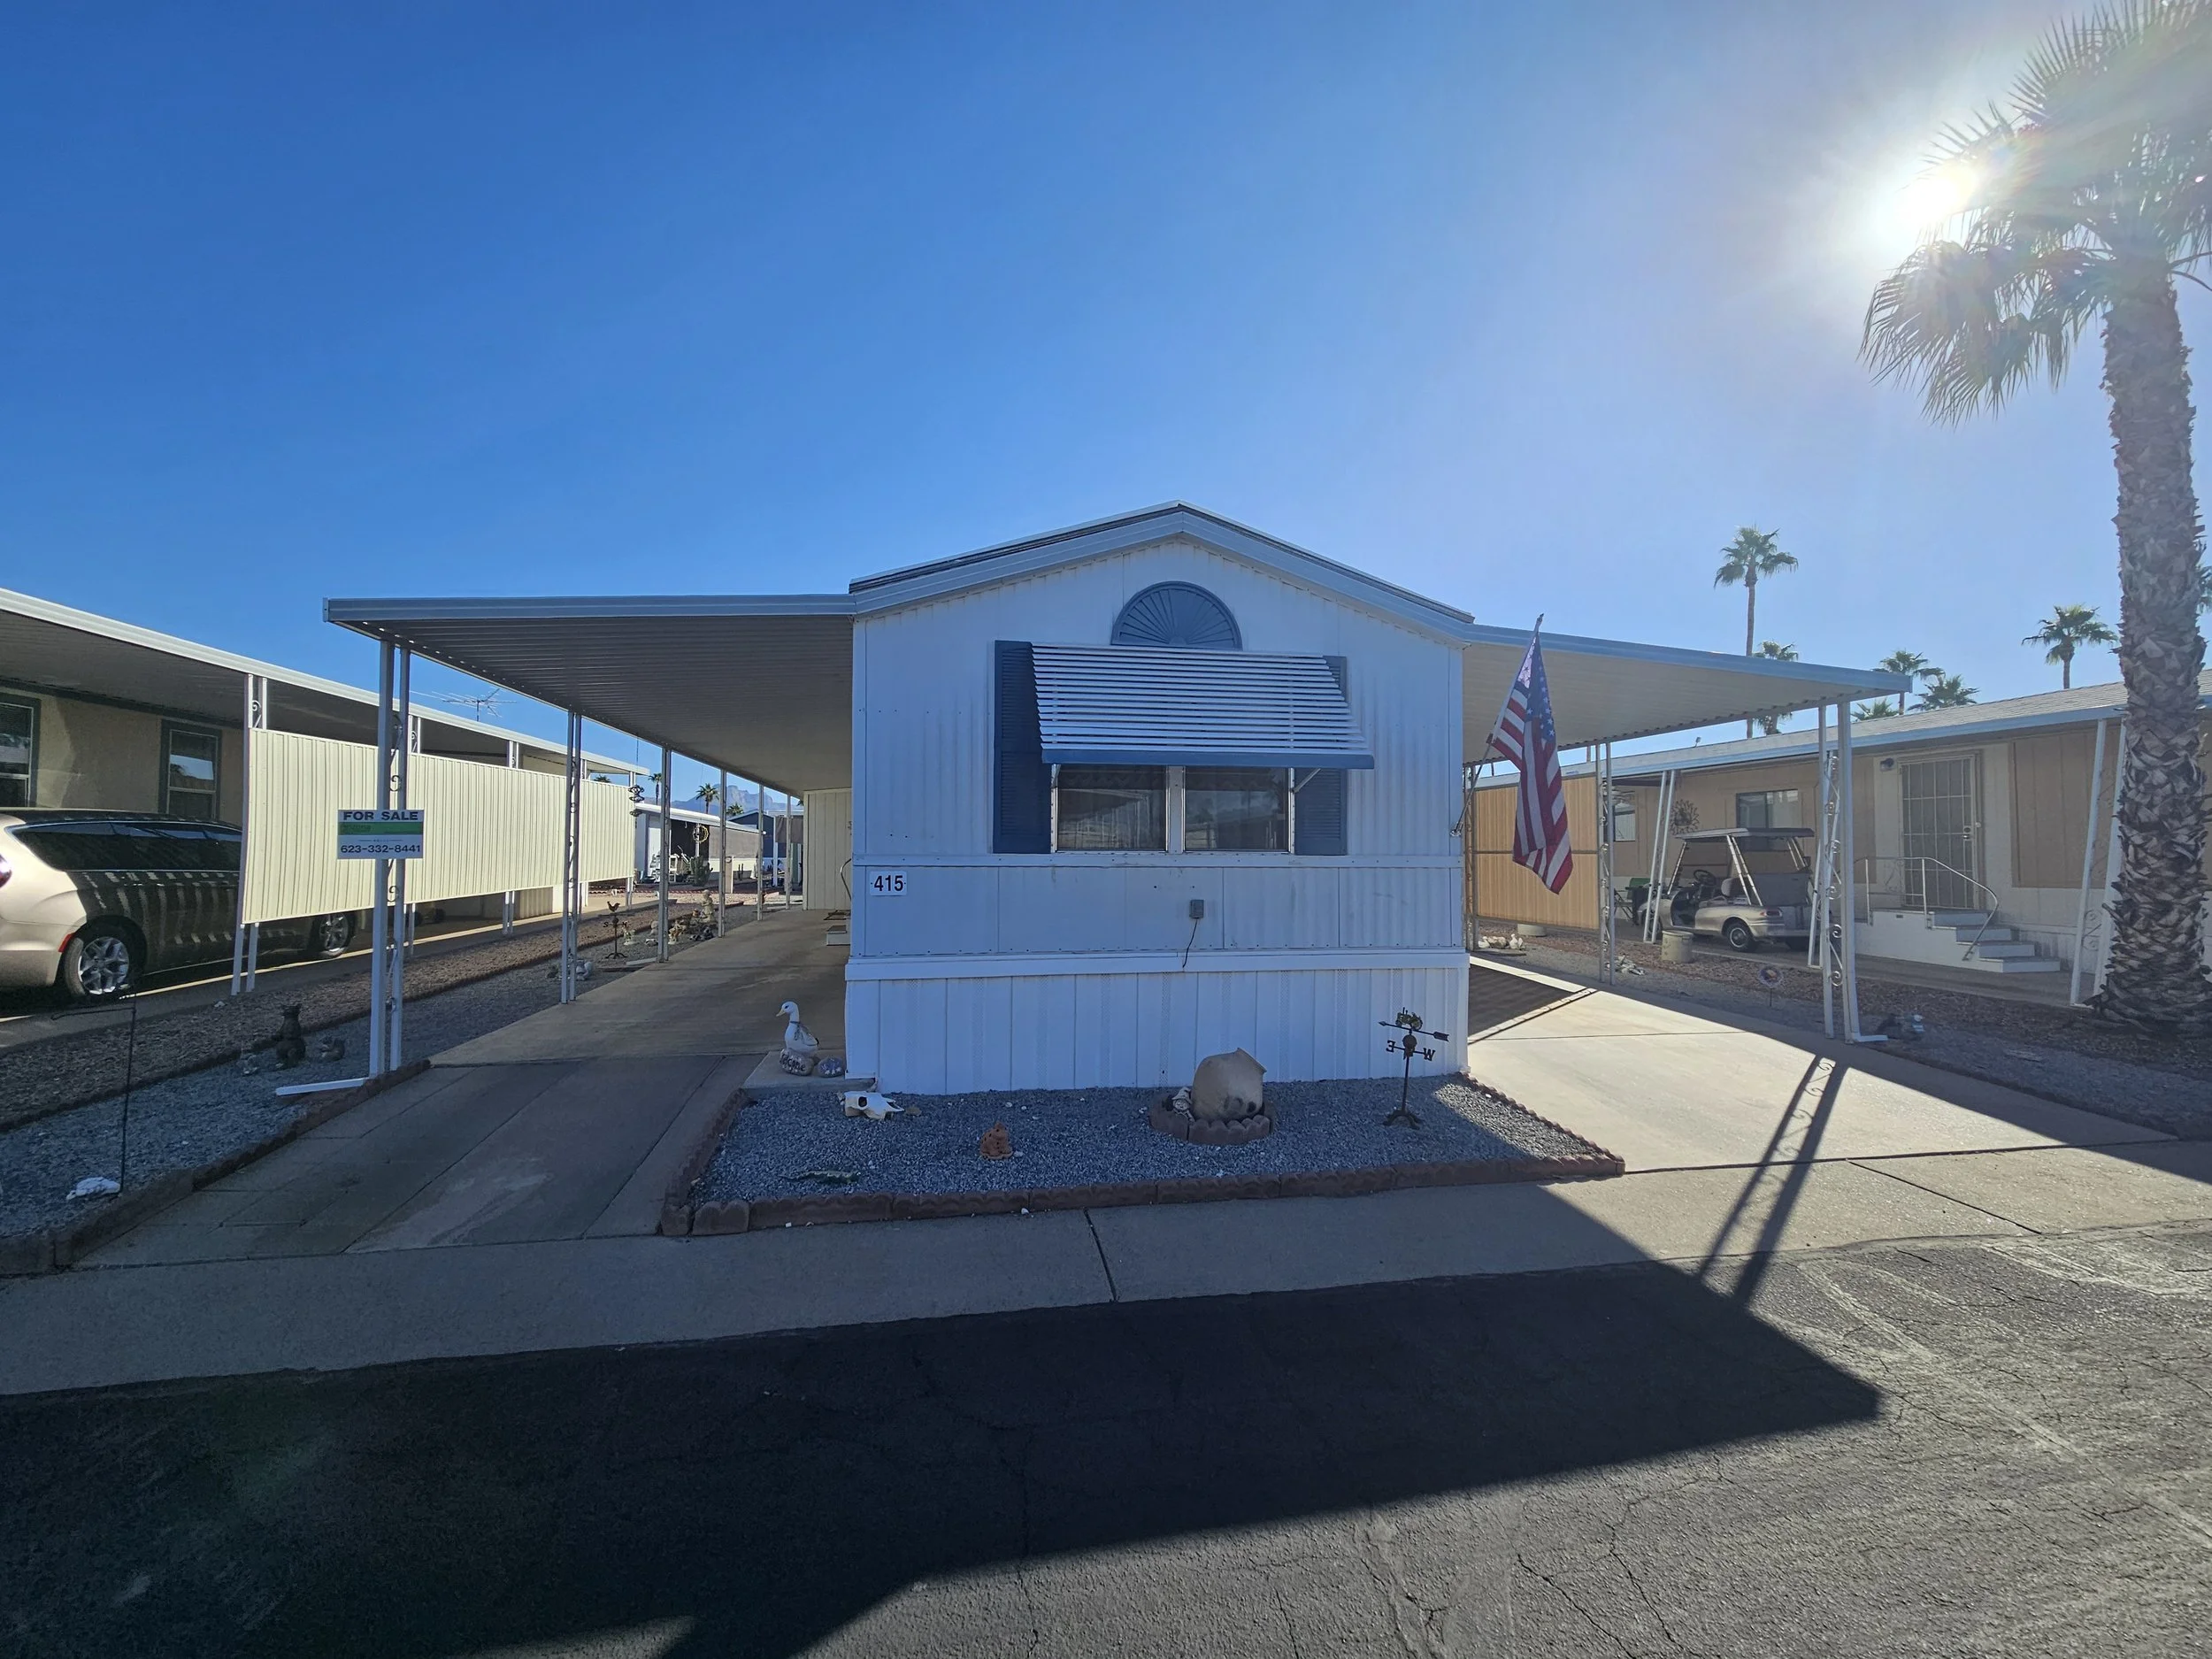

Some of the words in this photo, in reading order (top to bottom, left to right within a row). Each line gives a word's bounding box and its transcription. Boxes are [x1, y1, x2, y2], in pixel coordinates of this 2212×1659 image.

[343, 811, 374, 820] FOR
[381, 811, 419, 820] SALE
[874, 875, 903, 891] 415
